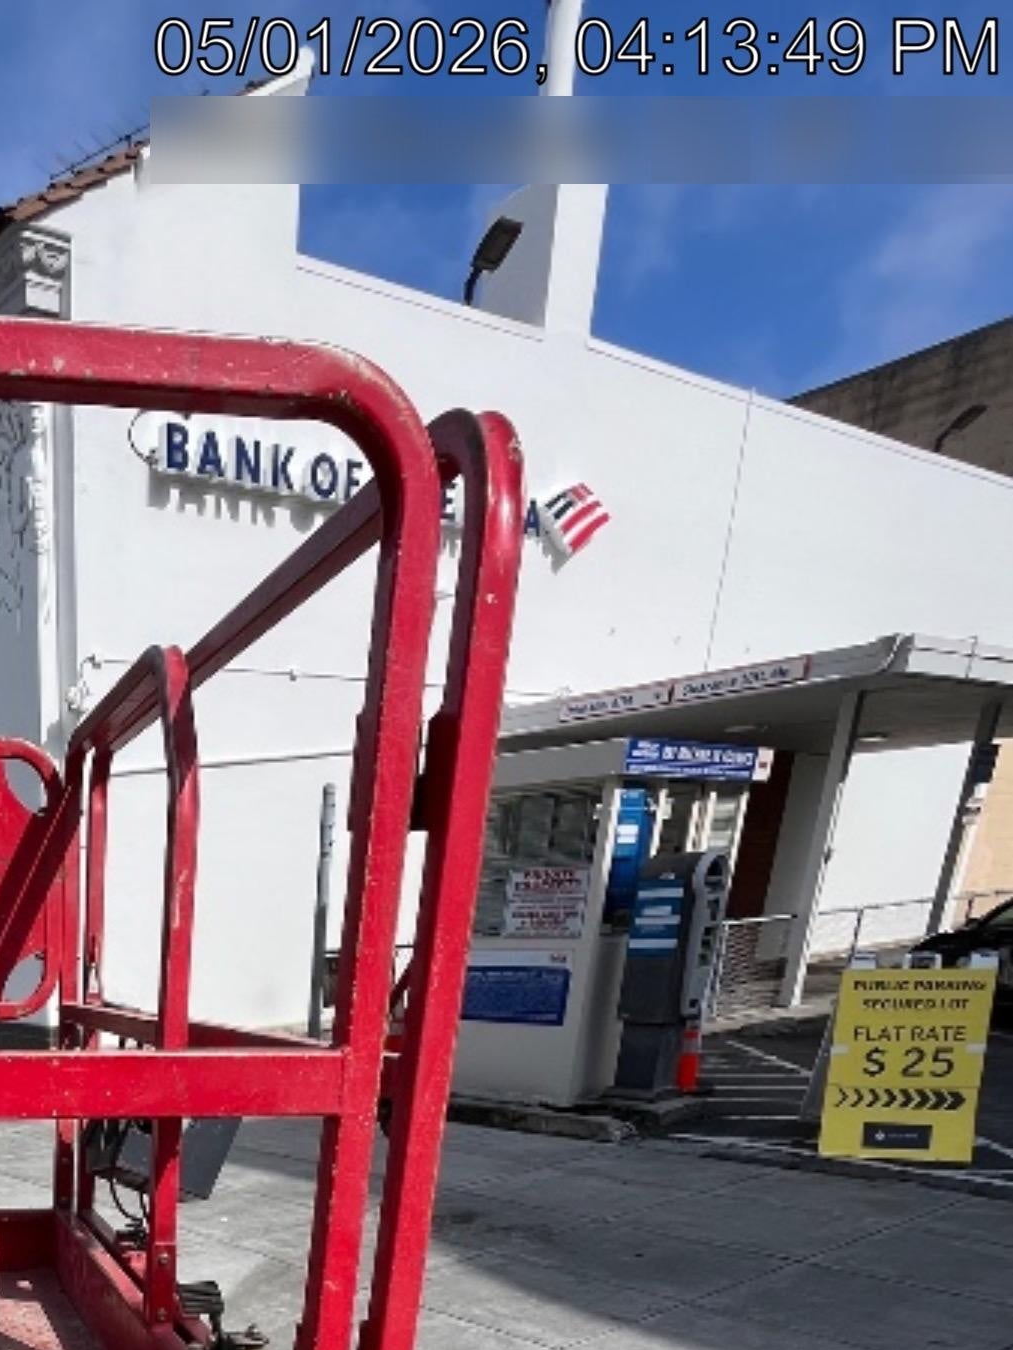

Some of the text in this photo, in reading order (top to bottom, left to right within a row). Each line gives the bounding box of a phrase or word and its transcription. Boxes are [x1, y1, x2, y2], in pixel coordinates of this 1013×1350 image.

[165, 422, 363, 501] BANK OF
[853, 979, 986, 992] PUBLIC PARKING
[853, 1026, 967, 1042] FLAT RATE
[862, 1047, 955, 1078] $ 25
